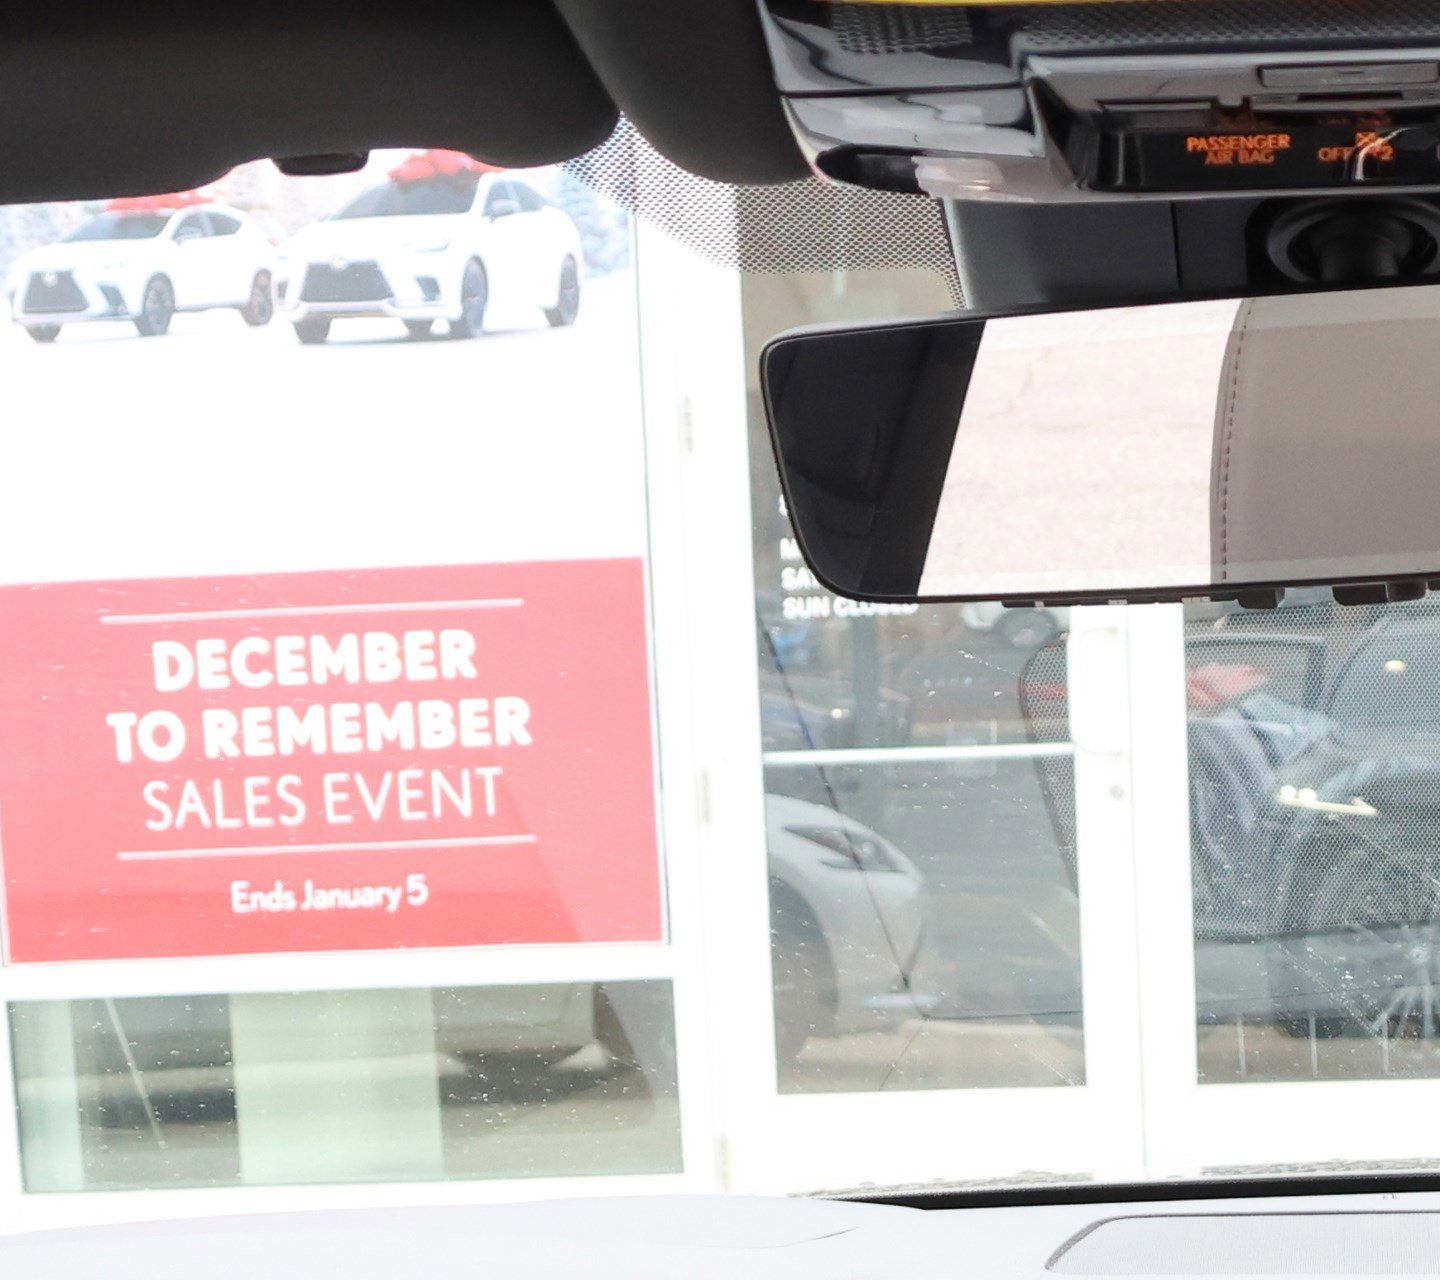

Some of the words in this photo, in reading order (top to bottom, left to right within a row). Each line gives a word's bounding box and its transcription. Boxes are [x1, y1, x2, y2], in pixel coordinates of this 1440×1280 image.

[1186, 134, 1291, 151] PASSENGER
[1205, 150, 1233, 165] AIR
[1238, 149, 1275, 165] BAG
[783, 596, 830, 619] SUN
[152, 628, 477, 692] DECEMBER
[106, 711, 186, 765] TO
[202, 697, 533, 760] REMEMBER
[142, 774, 307, 832] SALES
[324, 766, 504, 827] EVENT
[231, 879, 297, 914] Ends
[299, 877, 402, 915] January
[407, 874, 429, 907] 5
